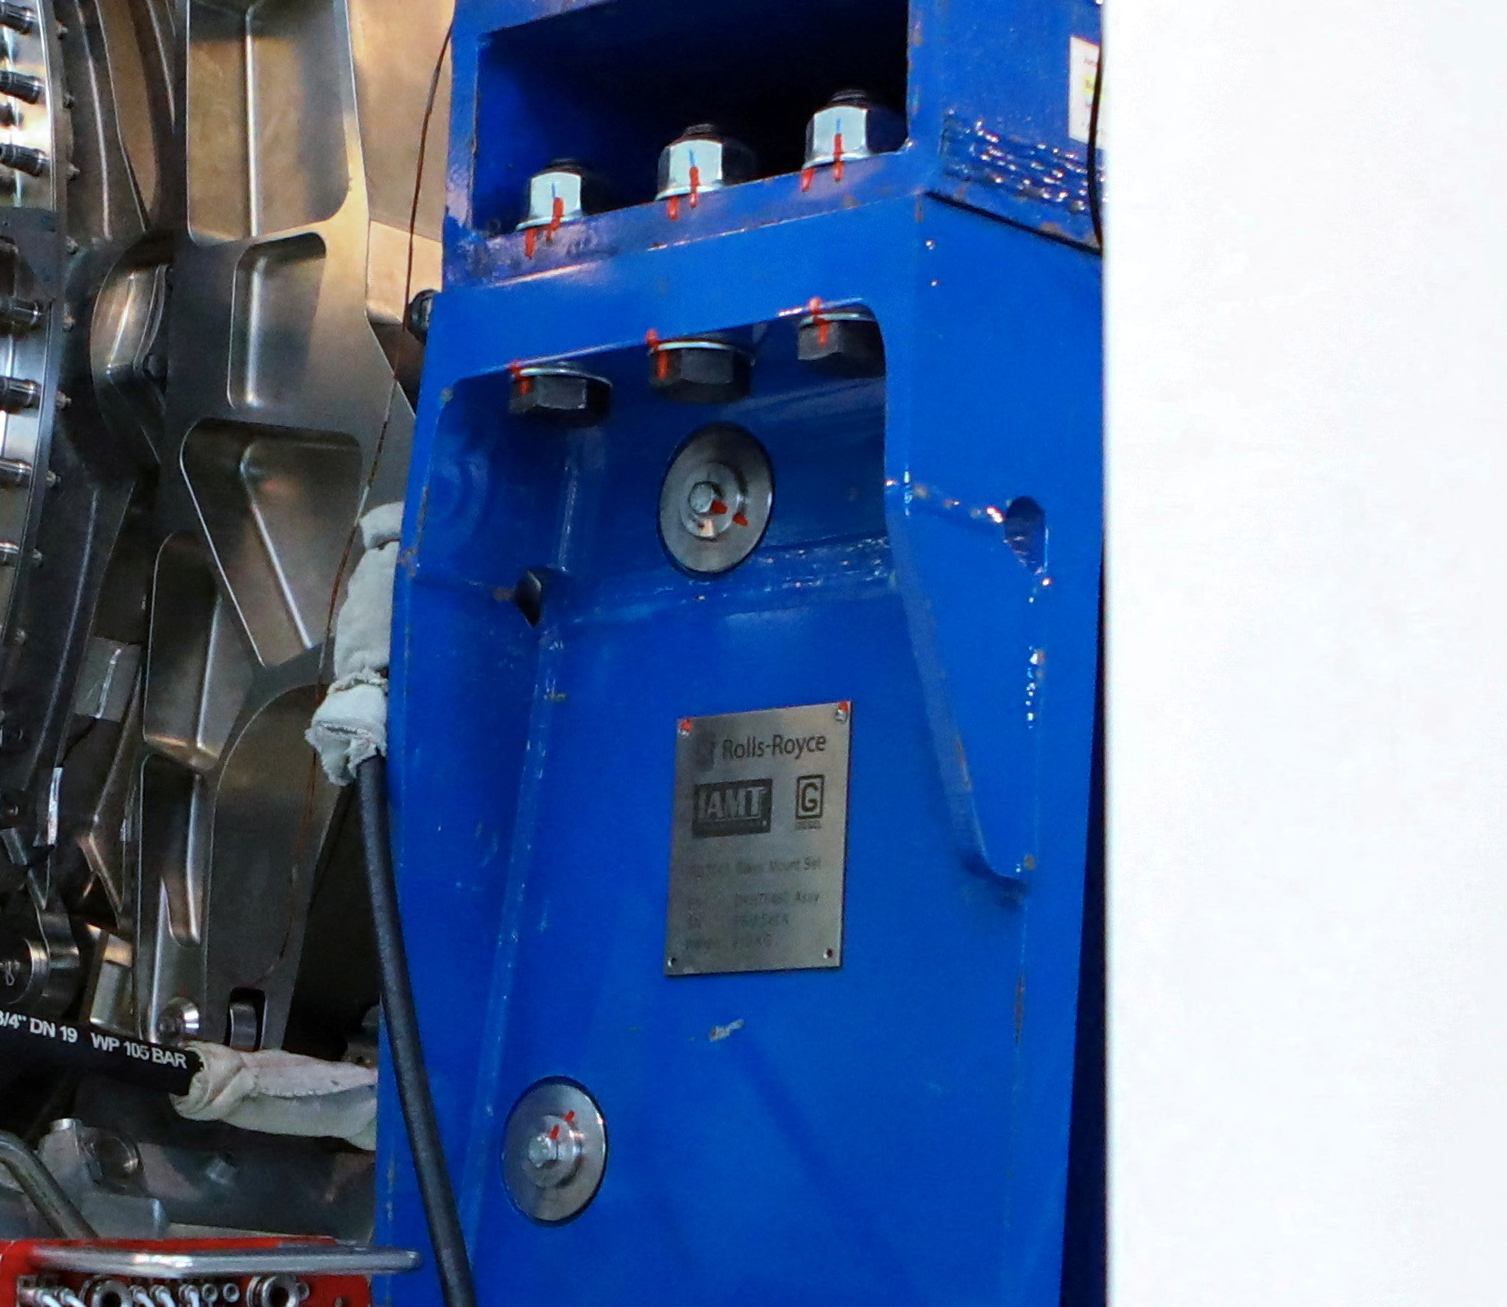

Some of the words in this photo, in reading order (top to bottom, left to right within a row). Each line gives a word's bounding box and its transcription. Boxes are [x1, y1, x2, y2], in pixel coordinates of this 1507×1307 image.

[722, 734, 827, 760] Rolls-Royce
[29, 1018, 56, 1041] DN
[59, 1025, 79, 1043] 19
[90, 1032, 120, 1053] WP
[123, 1041, 149, 1061] 105
[151, 1046, 187, 1069] BAR
